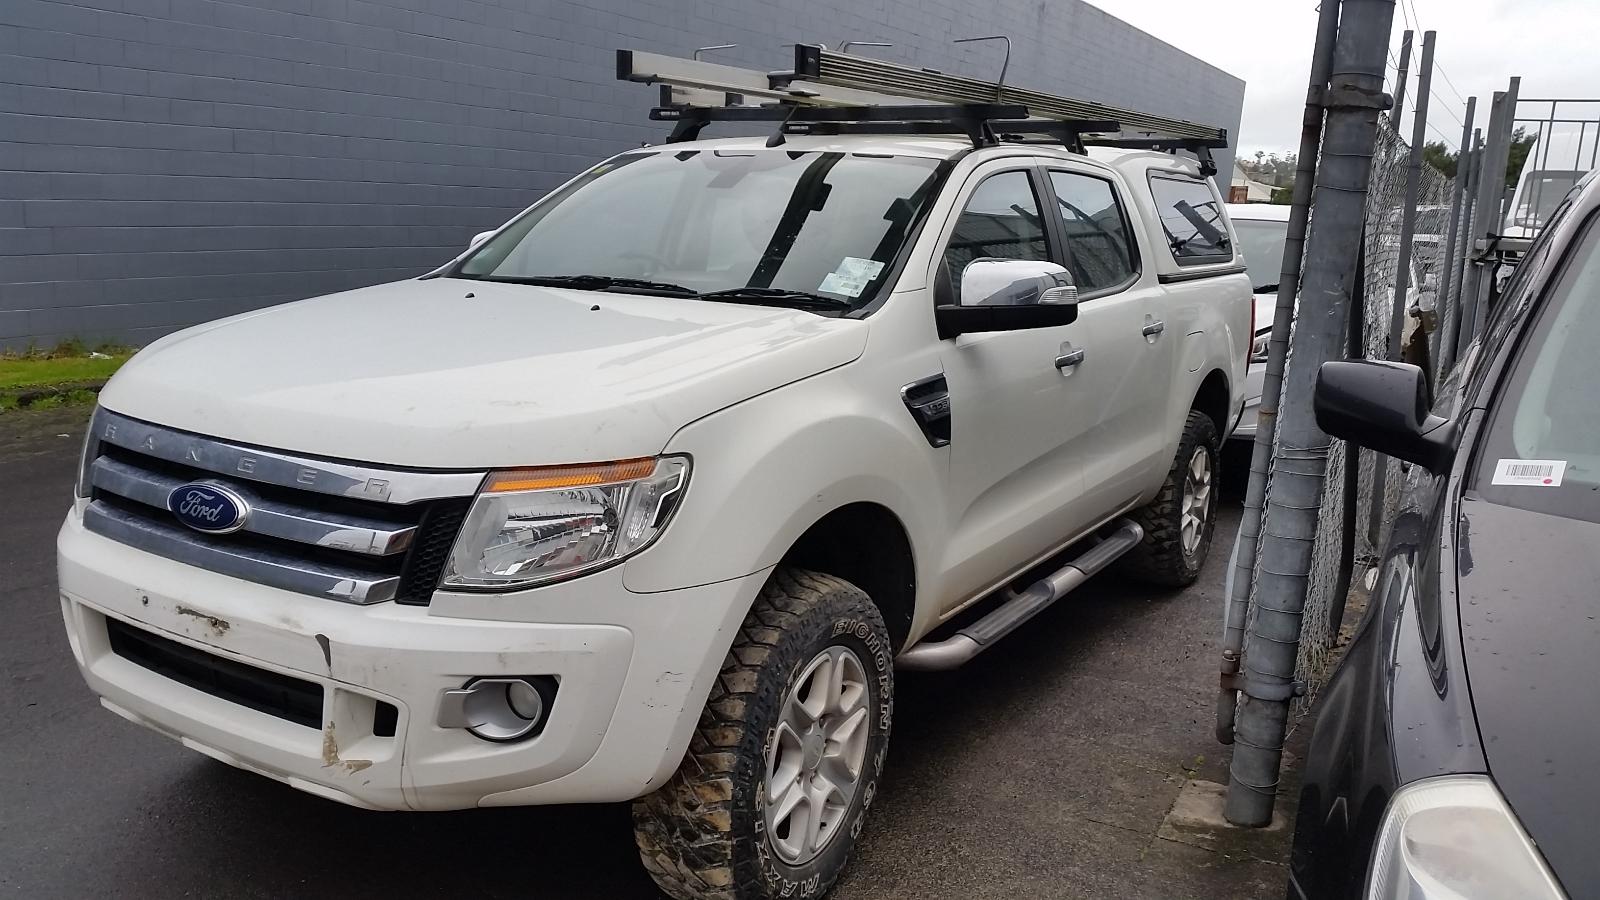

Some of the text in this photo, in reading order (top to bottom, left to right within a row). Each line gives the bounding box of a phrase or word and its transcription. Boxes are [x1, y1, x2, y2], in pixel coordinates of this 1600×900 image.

[104, 423, 392, 502] RANGER
[179, 489, 224, 523] Ford
[831, 619, 889, 730] BIGHORN
